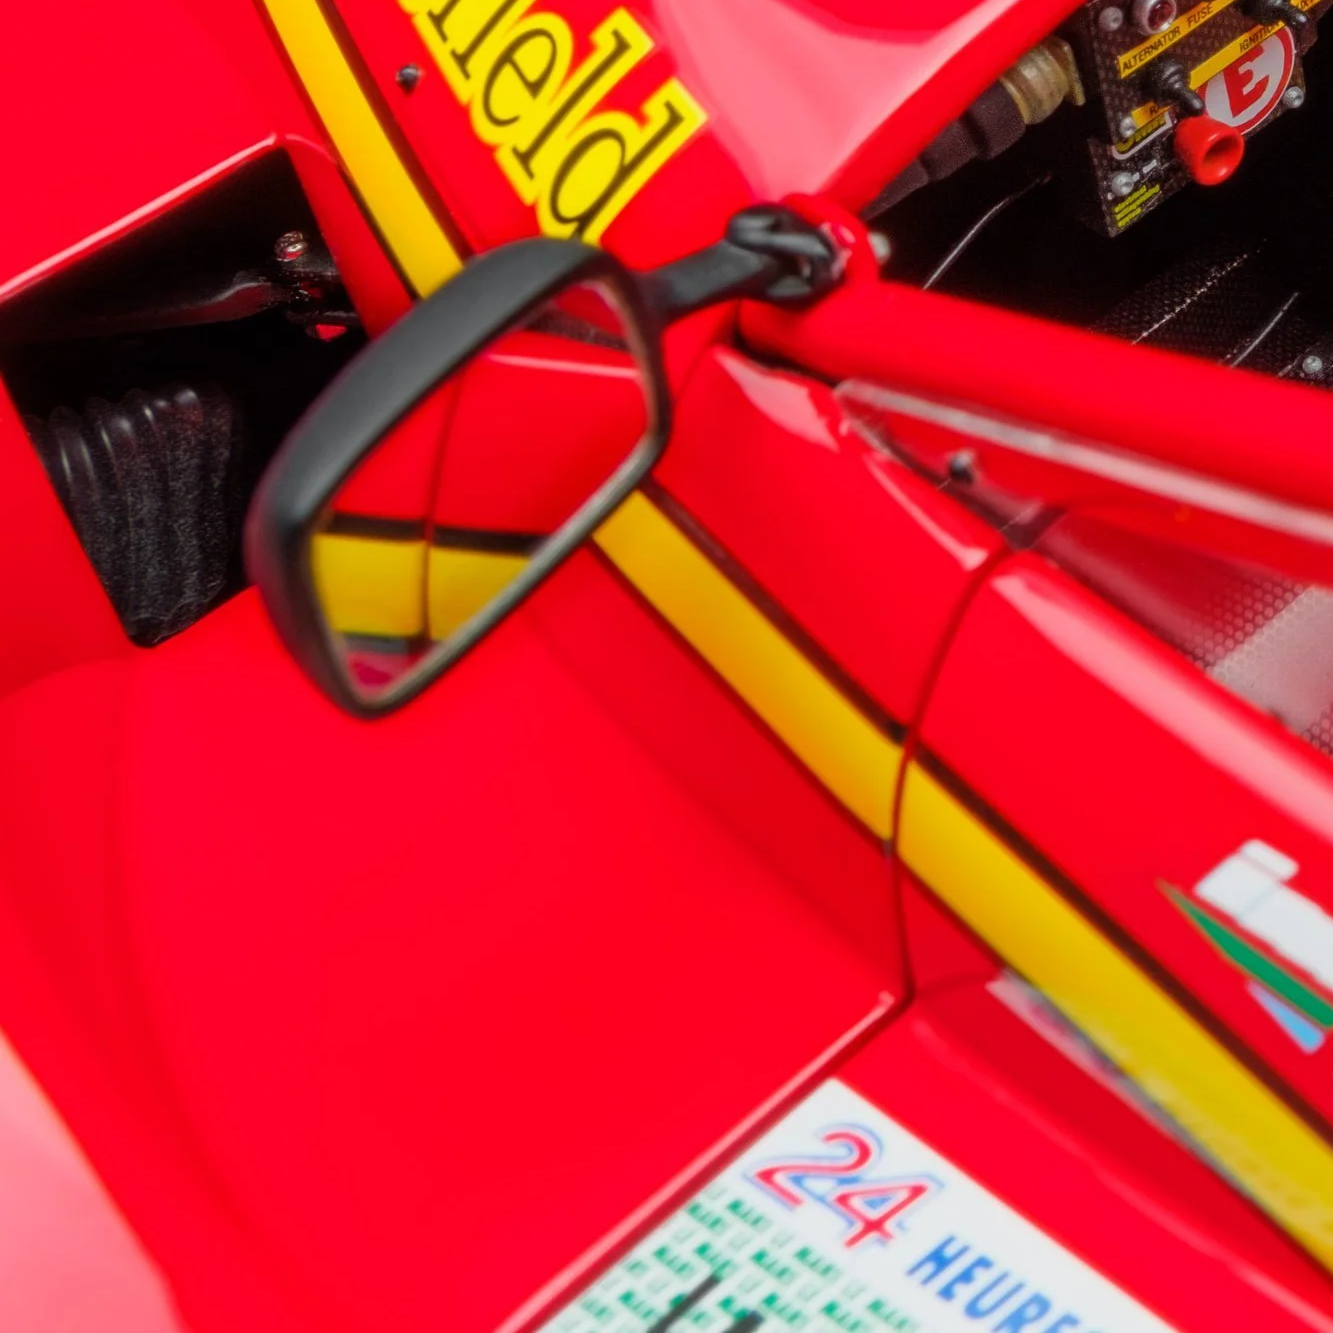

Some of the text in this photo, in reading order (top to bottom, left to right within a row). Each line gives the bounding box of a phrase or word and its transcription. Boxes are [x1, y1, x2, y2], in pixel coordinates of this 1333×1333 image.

[1121, 25, 1182, 73] ALTERNATOR
[1186, 2, 1214, 29] FUSE
[1221, 44, 1270, 119] E
[741, 1120, 946, 1249] 24
